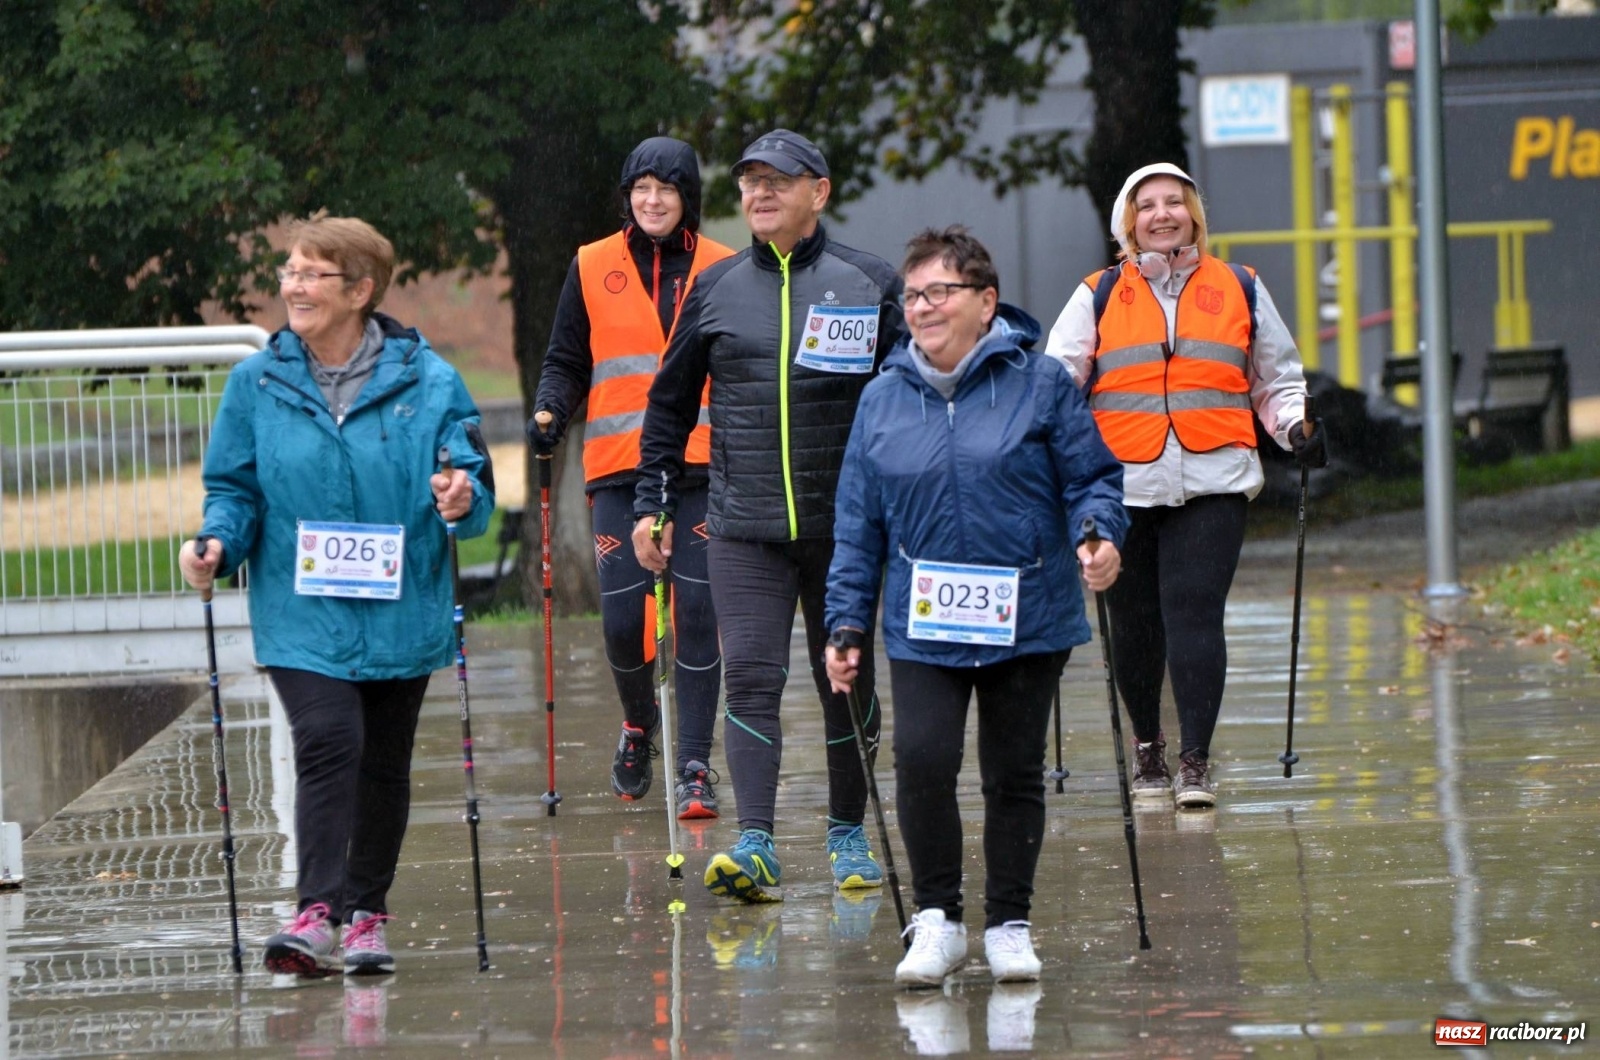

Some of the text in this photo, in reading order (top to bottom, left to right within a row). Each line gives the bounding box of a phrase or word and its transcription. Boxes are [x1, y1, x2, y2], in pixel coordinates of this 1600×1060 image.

[828, 319, 864, 341] 060
[325, 536, 375, 562] 026
[938, 582, 989, 610] 023
